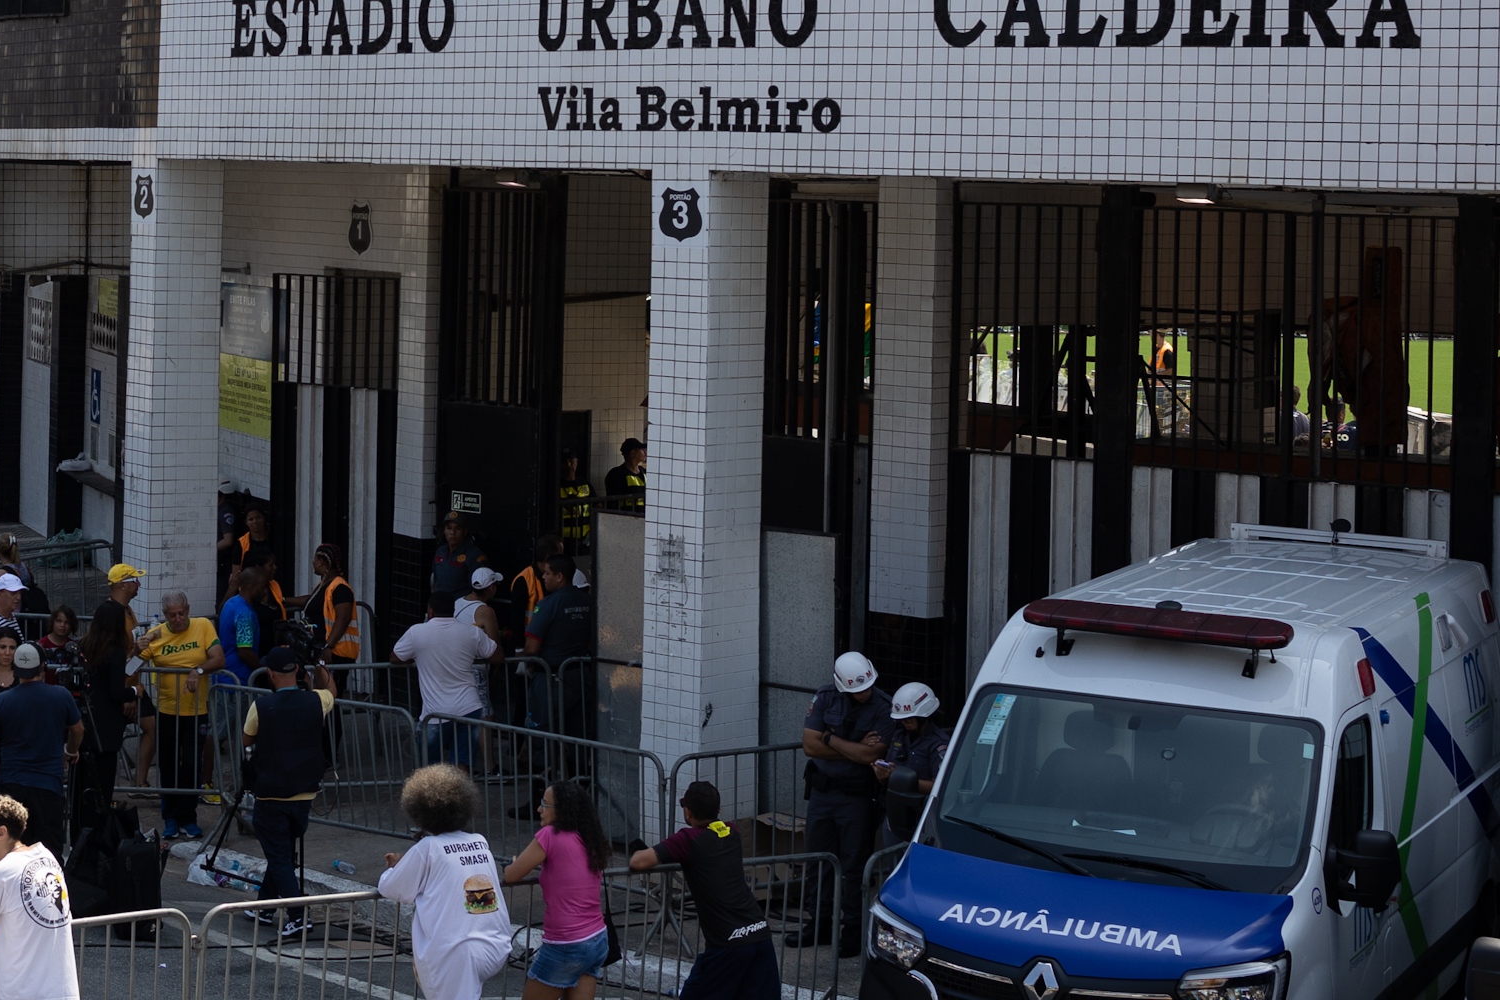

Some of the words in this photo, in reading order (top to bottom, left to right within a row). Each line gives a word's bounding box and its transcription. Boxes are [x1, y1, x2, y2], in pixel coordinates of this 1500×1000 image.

[538, 85, 623, 131] Vila
[637, 85, 842, 134] Belmiro
[140, 185, 148, 209] 2
[669, 192, 692, 201] PORTÃO
[672, 200, 689, 229] 3
[357, 221, 362, 240] 1
[229, 294, 242, 305] EVITE
[243, 296, 256, 306] FILAS
[161, 641, 200, 656] BRASIL
[903, 704, 912, 712] M
[460, 853, 489, 866] SMASH
